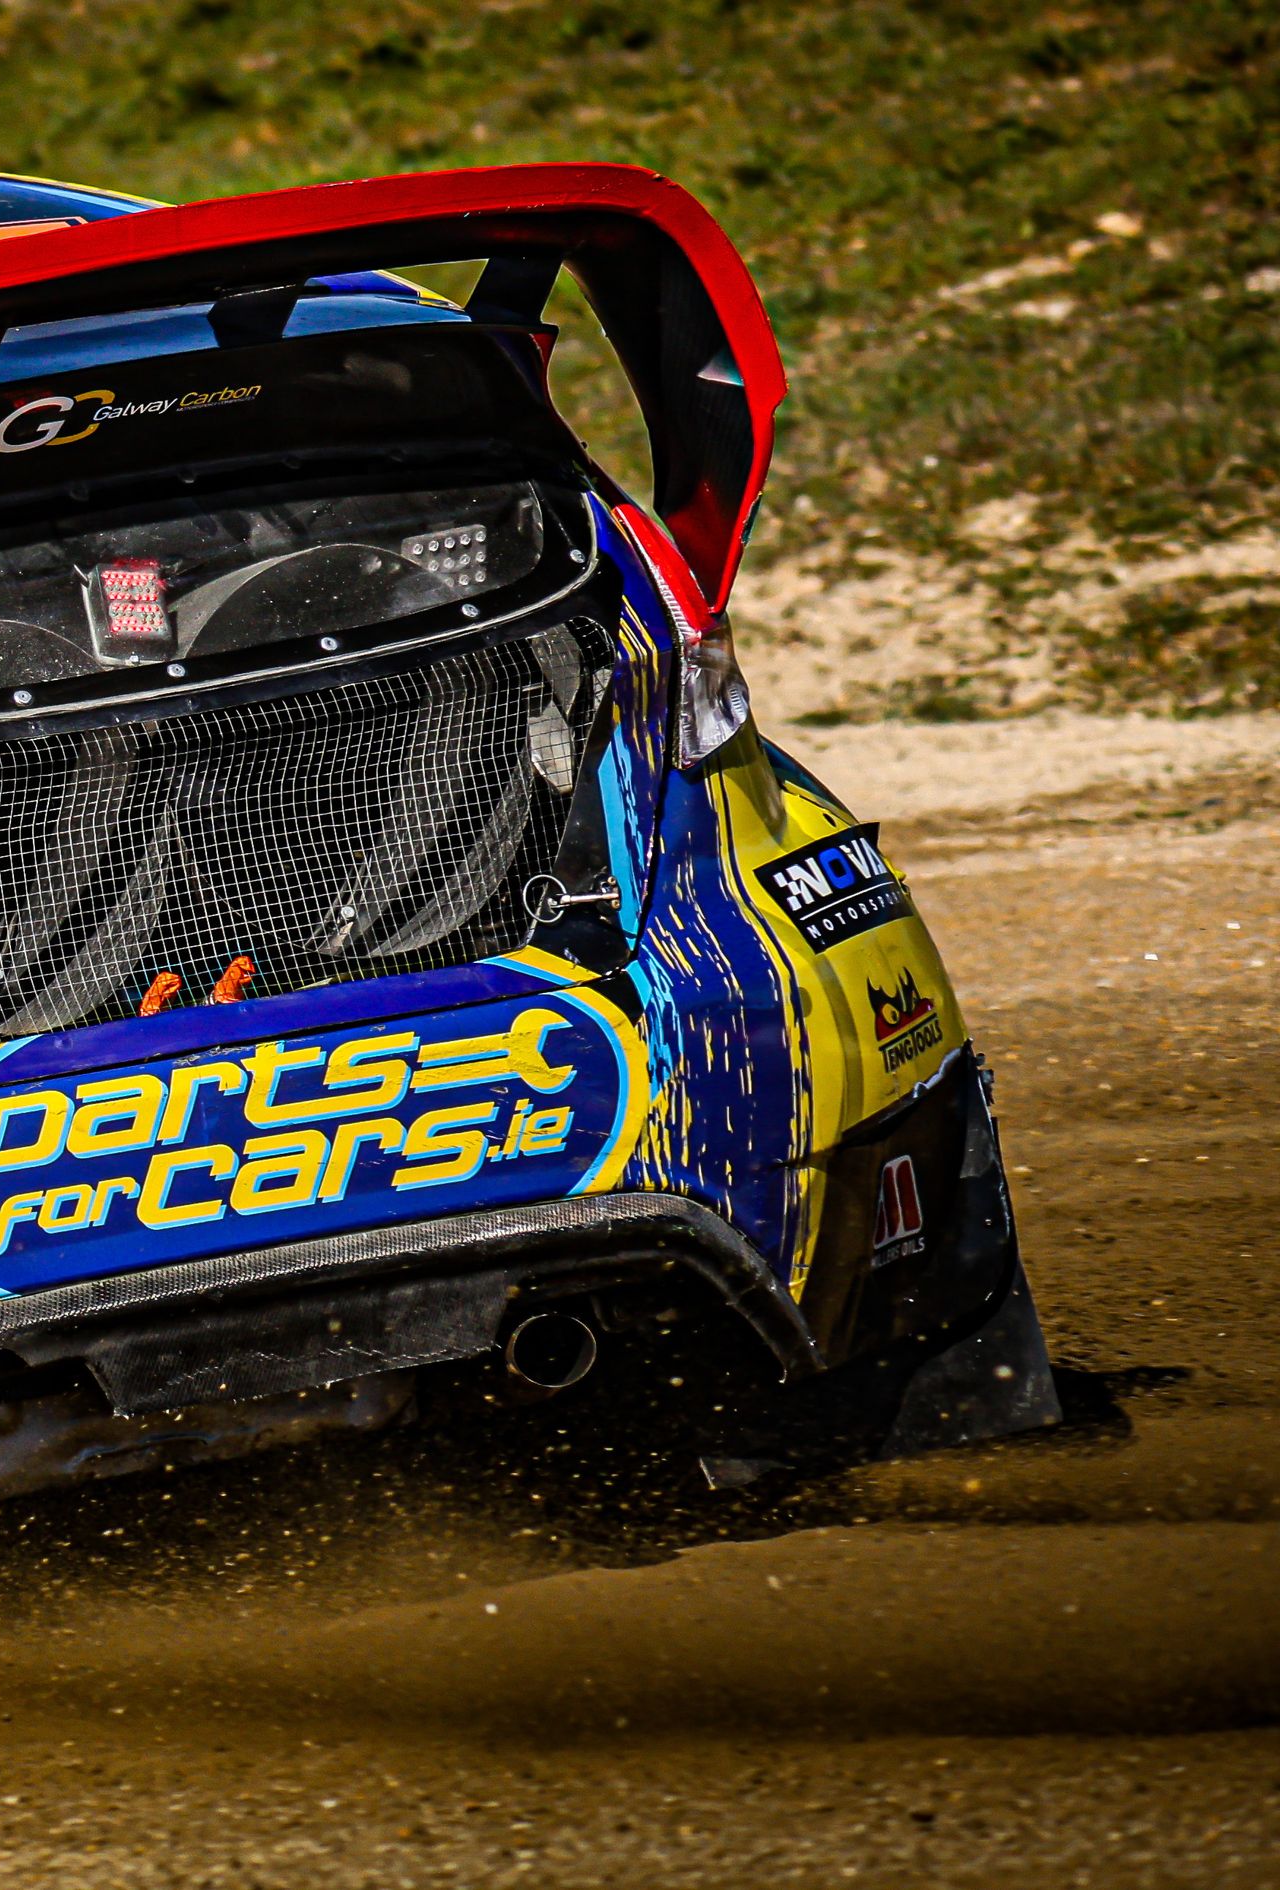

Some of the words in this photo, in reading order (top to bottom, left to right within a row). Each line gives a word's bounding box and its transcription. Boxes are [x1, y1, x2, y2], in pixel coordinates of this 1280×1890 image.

[92, 398, 178, 421] Galway
[180, 385, 262, 407] Carbon
[772, 837, 888, 912] NOVA
